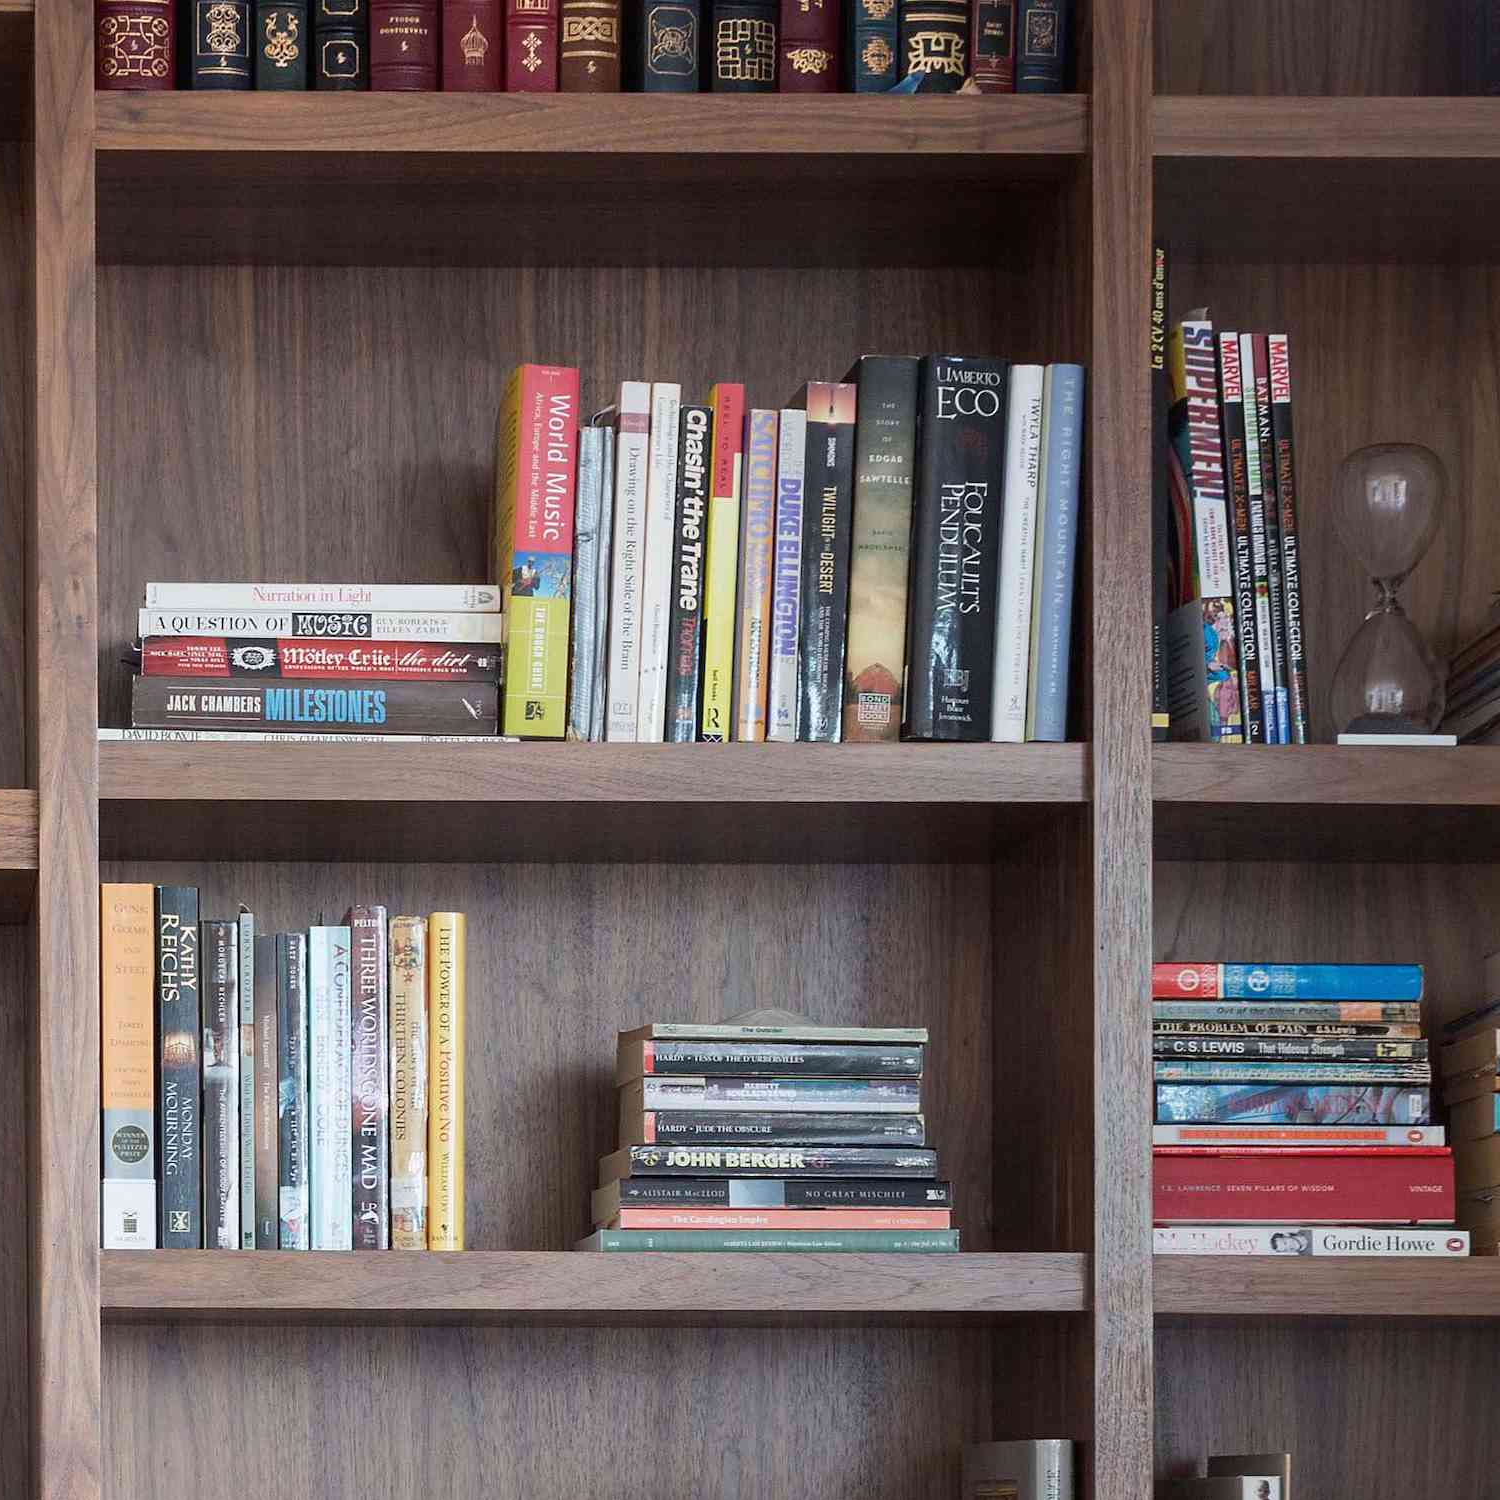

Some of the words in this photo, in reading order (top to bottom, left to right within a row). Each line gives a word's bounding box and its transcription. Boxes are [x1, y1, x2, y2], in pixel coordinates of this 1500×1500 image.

[936, 367, 1000, 386] UMBERTO
[1222, 341, 1238, 399] MARVEL
[1271, 342, 1288, 400] MARVEL
[533, 392, 544, 420] Africa,
[935, 387, 1000, 420] ECO
[1062, 378, 1075, 416] THE
[1183, 325, 1226, 499] SUPERMEN!
[1257, 377, 1270, 442] BATMAN:
[530, 423, 542, 450] Europe
[547, 395, 571, 463] World
[1029, 398, 1040, 440] TWYLA
[531, 454, 540, 470] and
[626, 447, 641, 495] Drawing
[684, 410, 707, 495] Chasin'
[1027, 446, 1038, 488] THARP
[1060, 427, 1073, 488] RIGHT
[530, 472, 540, 485] the
[529, 489, 540, 517] Middle
[543, 473, 567, 540] Music
[626, 500, 637, 513] on
[682, 496, 704, 539] the
[779, 478, 802, 534] DUKE
[821, 486, 836, 538] TWILIGHT
[528, 520, 538, 538] East
[626, 517, 639, 537] the
[622, 540, 637, 570] Right
[936, 484, 965, 610] PENDULUM
[960, 482, 988, 614] FOUCAULT'S
[1053, 499, 1068, 603] MOUNTAIN
[1237, 536, 1251, 588] ULTIMATE
[1284, 536, 1298, 589] ULTIMATE
[624, 574, 635, 598] Side
[680, 542, 701, 610] Trane
[819, 553, 835, 594] DESERT
[253, 587, 316, 602] Narration
[320, 589, 332, 601] in
[339, 588, 372, 607] Light
[534, 608, 545, 624] THE
[624, 602, 636, 614] of
[775, 539, 799, 656] ELLINGTON
[155, 616, 165, 629] A
[172, 616, 257, 632] QUESTION
[266, 616, 289, 630] OF
[298, 615, 367, 636] MUSIC
[533, 628, 545, 656] ROUGH
[623, 617, 636, 637] the
[1242, 592, 1255, 661] COLLECTION
[1288, 592, 1302, 661] COLLECTION
[283, 647, 344, 666] Mötley
[349, 649, 391, 666] Crüe
[399, 649, 427, 666] the
[432, 650, 471, 666] dirt
[621, 640, 634, 670] Brain
[531, 661, 544, 689] GUIDE
[167, 695, 196, 712] JACK
[202, 696, 261, 713] CHAMBERS
[265, 689, 386, 724] MILESTONES
[162, 914, 178, 1001] REICHS
[180, 926, 196, 990] KATHY
[438, 927, 451, 957] THE
[360, 934, 377, 994] THREE
[438, 960, 451, 1011] POWER
[361, 998, 377, 1074] WORLDS
[439, 1013, 451, 1034] OF
[439, 1036, 451, 1046] A
[1203, 1042, 1245, 1053] LEWIS
[438, 1050, 452, 1113] Positive
[361, 1079, 377, 1137] GONE
[166, 1081, 178, 1175] MOURNING
[181, 1097, 192, 1159] MONDAY
[438, 1117, 452, 1142] No
[361, 1144, 377, 1189] MAD
[666, 1151, 721, 1168] JOHN
[725, 1151, 805, 1168] BERGER
[1410, 1185, 1443, 1193] VINTAGE
[1323, 1233, 1382, 1252] Gordie
[1386, 1235, 1435, 1251] Howe
